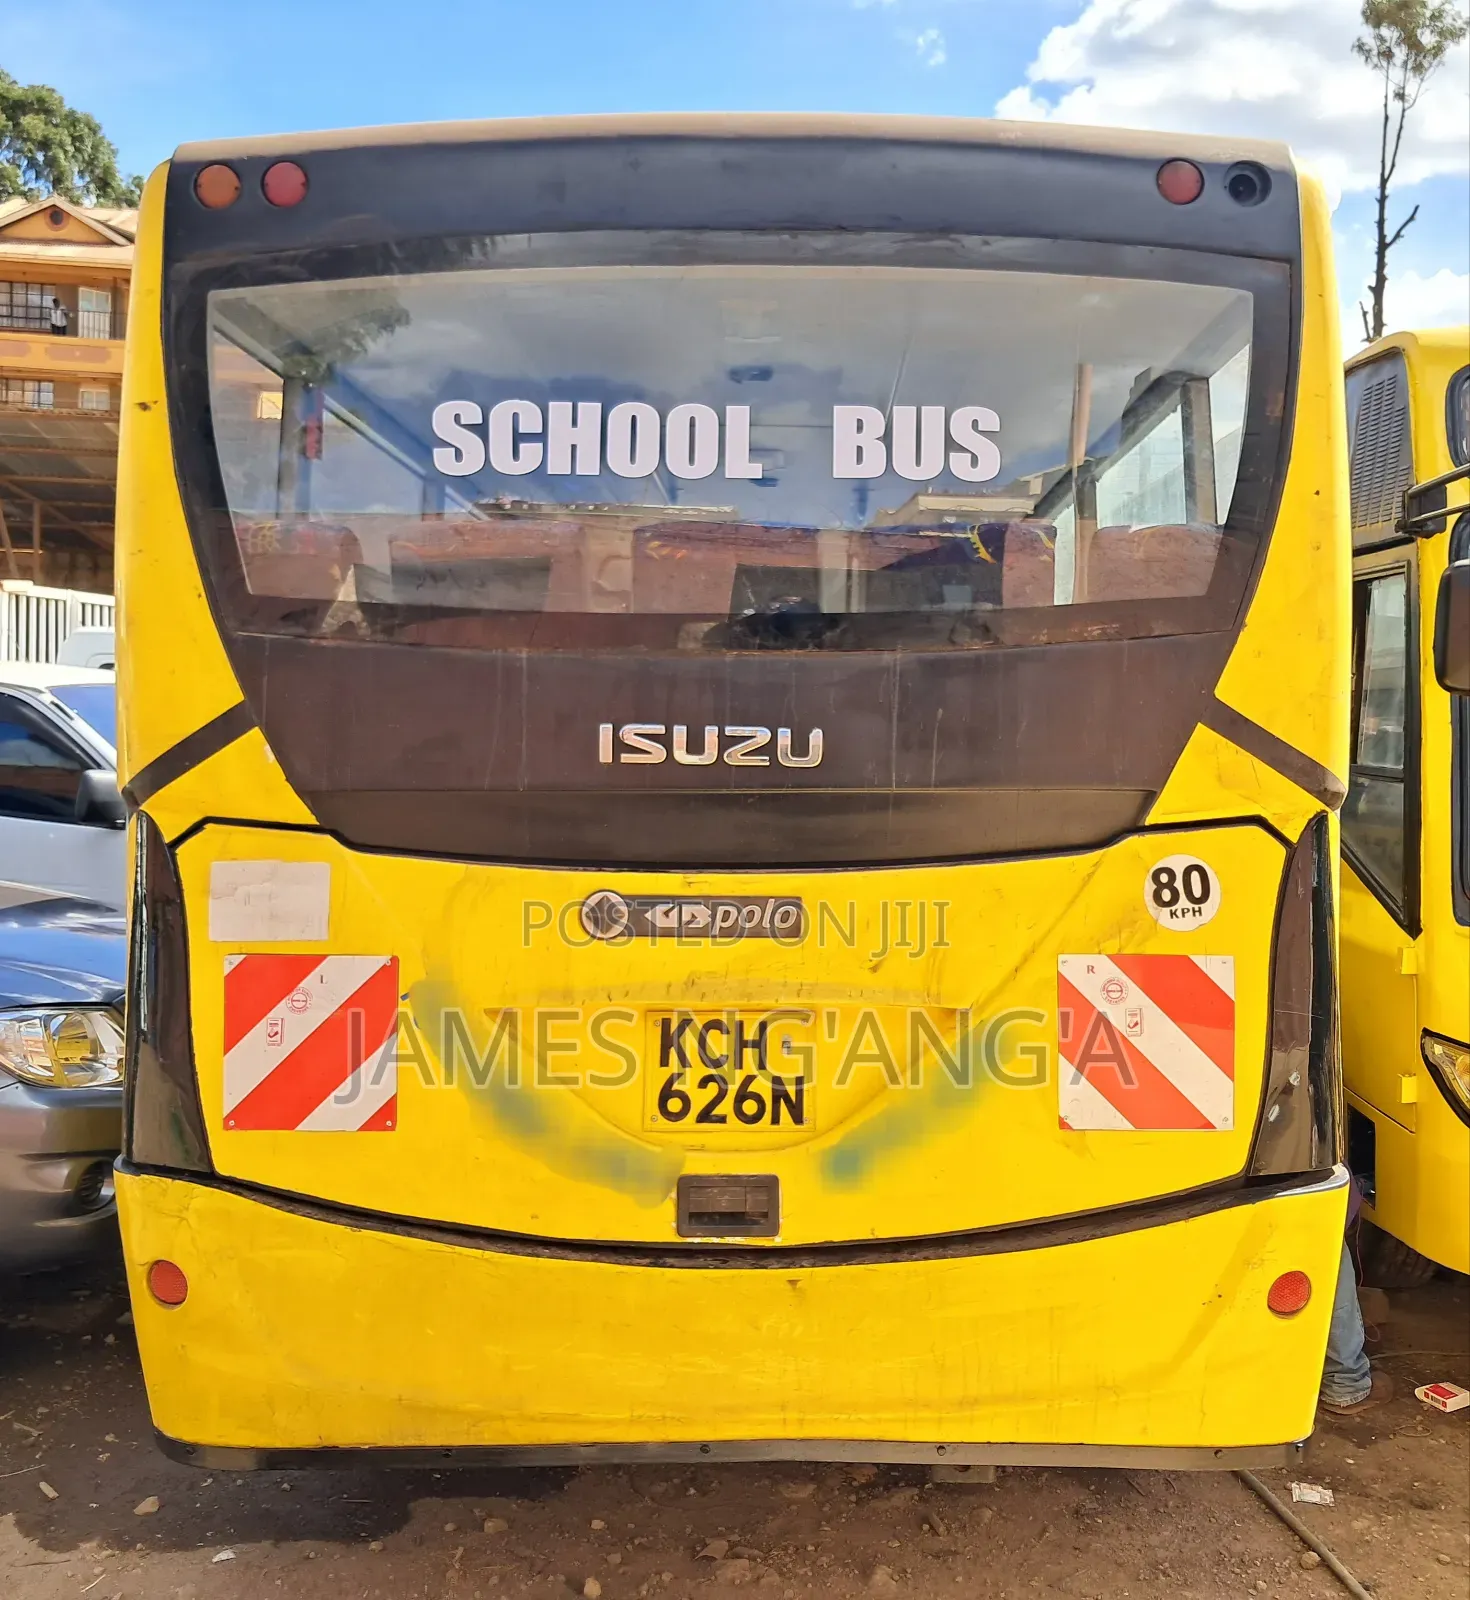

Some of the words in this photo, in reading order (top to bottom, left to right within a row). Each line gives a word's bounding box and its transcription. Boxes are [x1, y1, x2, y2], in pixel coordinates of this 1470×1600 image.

[432, 399, 763, 480] SCHOOL
[833, 404, 1001, 482] BUS
[598, 723, 824, 768] ISUZU
[1151, 863, 1211, 908] 80
[1169, 906, 1203, 920] KPH
[1086, 964, 1096, 975] R
[659, 1017, 768, 1070] KCH
[657, 1071, 805, 1126] 626N
